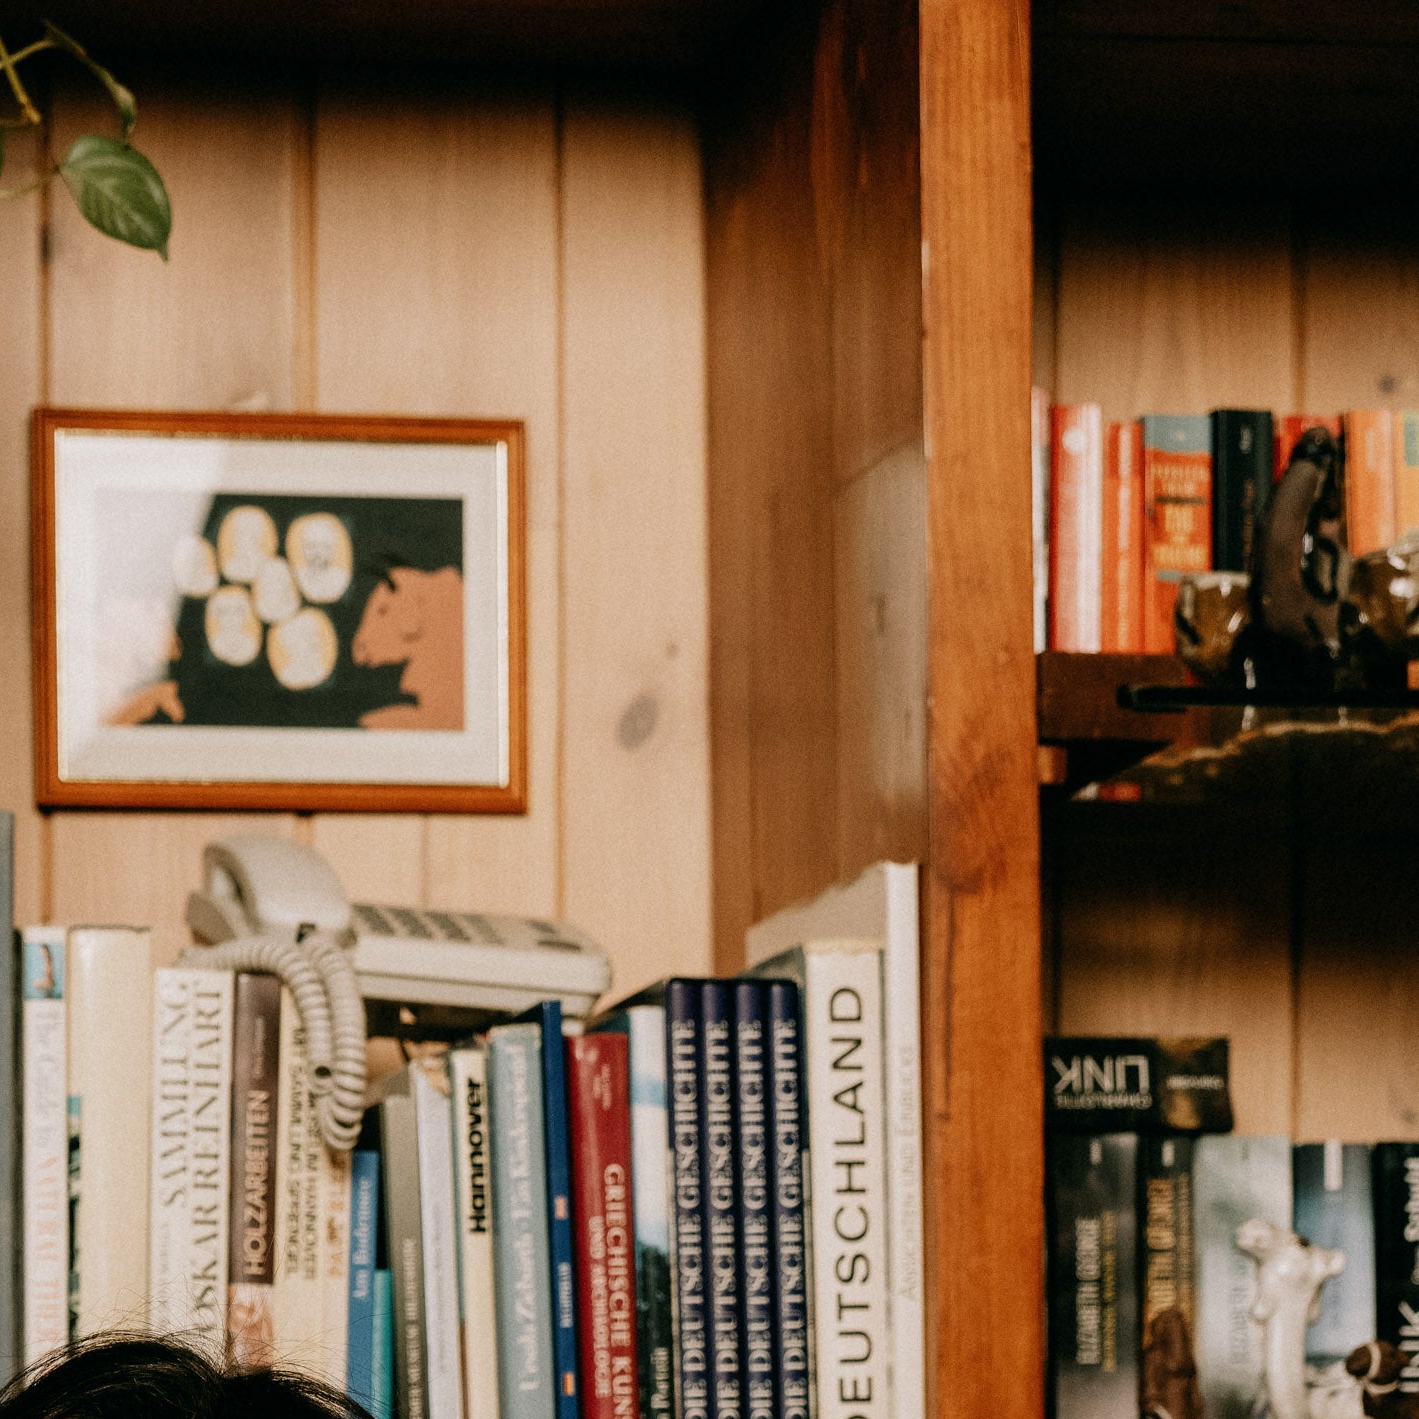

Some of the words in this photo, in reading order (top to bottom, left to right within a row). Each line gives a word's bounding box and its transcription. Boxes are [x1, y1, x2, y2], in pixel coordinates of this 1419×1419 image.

[158, 982, 189, 1208] SAMMLUNG
[190, 988, 221, 1191] REINHART
[465, 1077, 487, 1234] Hannover
[671, 1018, 702, 1211] GESCHICHTE
[704, 1018, 735, 1211] GESCHICHTE
[737, 1018, 767, 1211] GESCHICHTE
[773, 1018, 802, 1211] GESCHICHTE
[1051, 1055, 1150, 1095] LINK
[243, 1089, 271, 1276] HOLZARBEITEN
[602, 1163, 630, 1348] GRIECHISCHE
[679, 1214, 708, 1373] DEUTSCHE
[712, 1214, 741, 1373] DEUTSCHE
[745, 1214, 773, 1373] DEUTSCHE
[779, 1212, 807, 1371] DEUTSCHE
